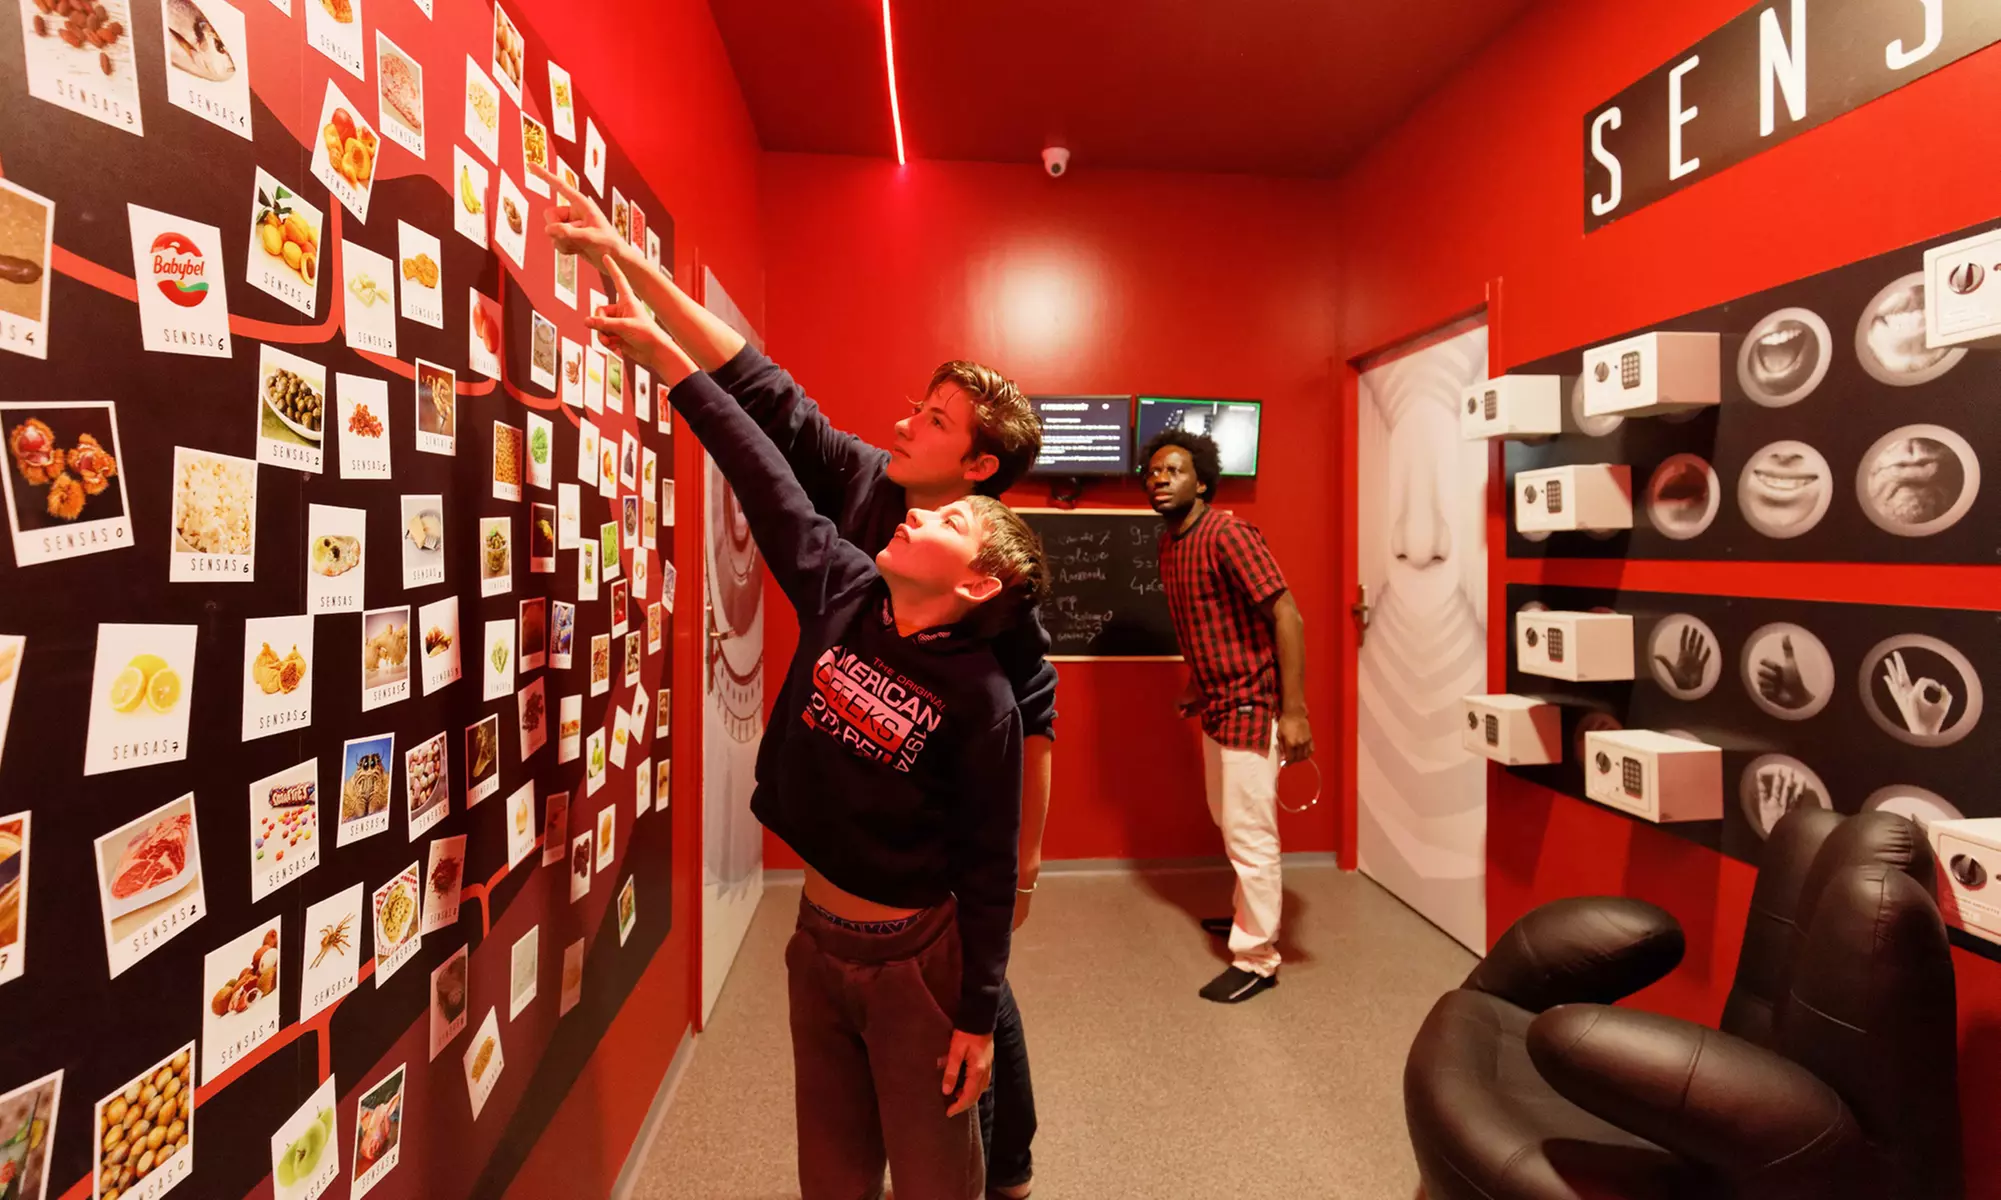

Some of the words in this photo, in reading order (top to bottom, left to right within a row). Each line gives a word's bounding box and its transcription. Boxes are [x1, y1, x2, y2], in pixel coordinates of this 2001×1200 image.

[56, 78, 120, 118] SENSAS
[126, 110, 135, 125] 3
[188, 90, 235, 125] SENSAS
[324, 168, 356, 208] SENSAS
[153, 255, 205, 283] Babybel
[263, 271, 302, 303] SENSAS
[305, 299, 312, 311] 6
[24, 331, 35, 346] 4
[163, 328, 214, 347] SENSAS
[217, 337, 224, 351] 6
[358, 330, 387, 349] SENSAS
[272, 444, 311, 464] SENSAS
[313, 456, 320, 467] 2
[351, 459, 381, 472] SENSAS
[43, 527, 109, 553] SENSAS
[190, 557, 238, 572] SENSAS
[242, 562, 250, 574] 6
[320, 595, 353, 608] SENSAS
[373, 685, 401, 702] SENSAS
[400, 681, 406, 692] 5
[873, 657, 896, 677] THE
[896, 674, 949, 715] ORIGINAL
[259, 708, 299, 730] SENSAS
[299, 710, 308, 722] 5
[112, 739, 168, 761] SENSAS
[171, 740, 179, 753] 7
[893, 730, 928, 774] 1974
[349, 820, 380, 838] SENSAS
[268, 856, 307, 887] SENSAS
[132, 907, 187, 953] SENSAS
[189, 904, 198, 917] 2
[386, 942, 412, 972] SENSAS
[314, 976, 348, 1007] SENSAS
[221, 1025, 265, 1066] SENSAS
